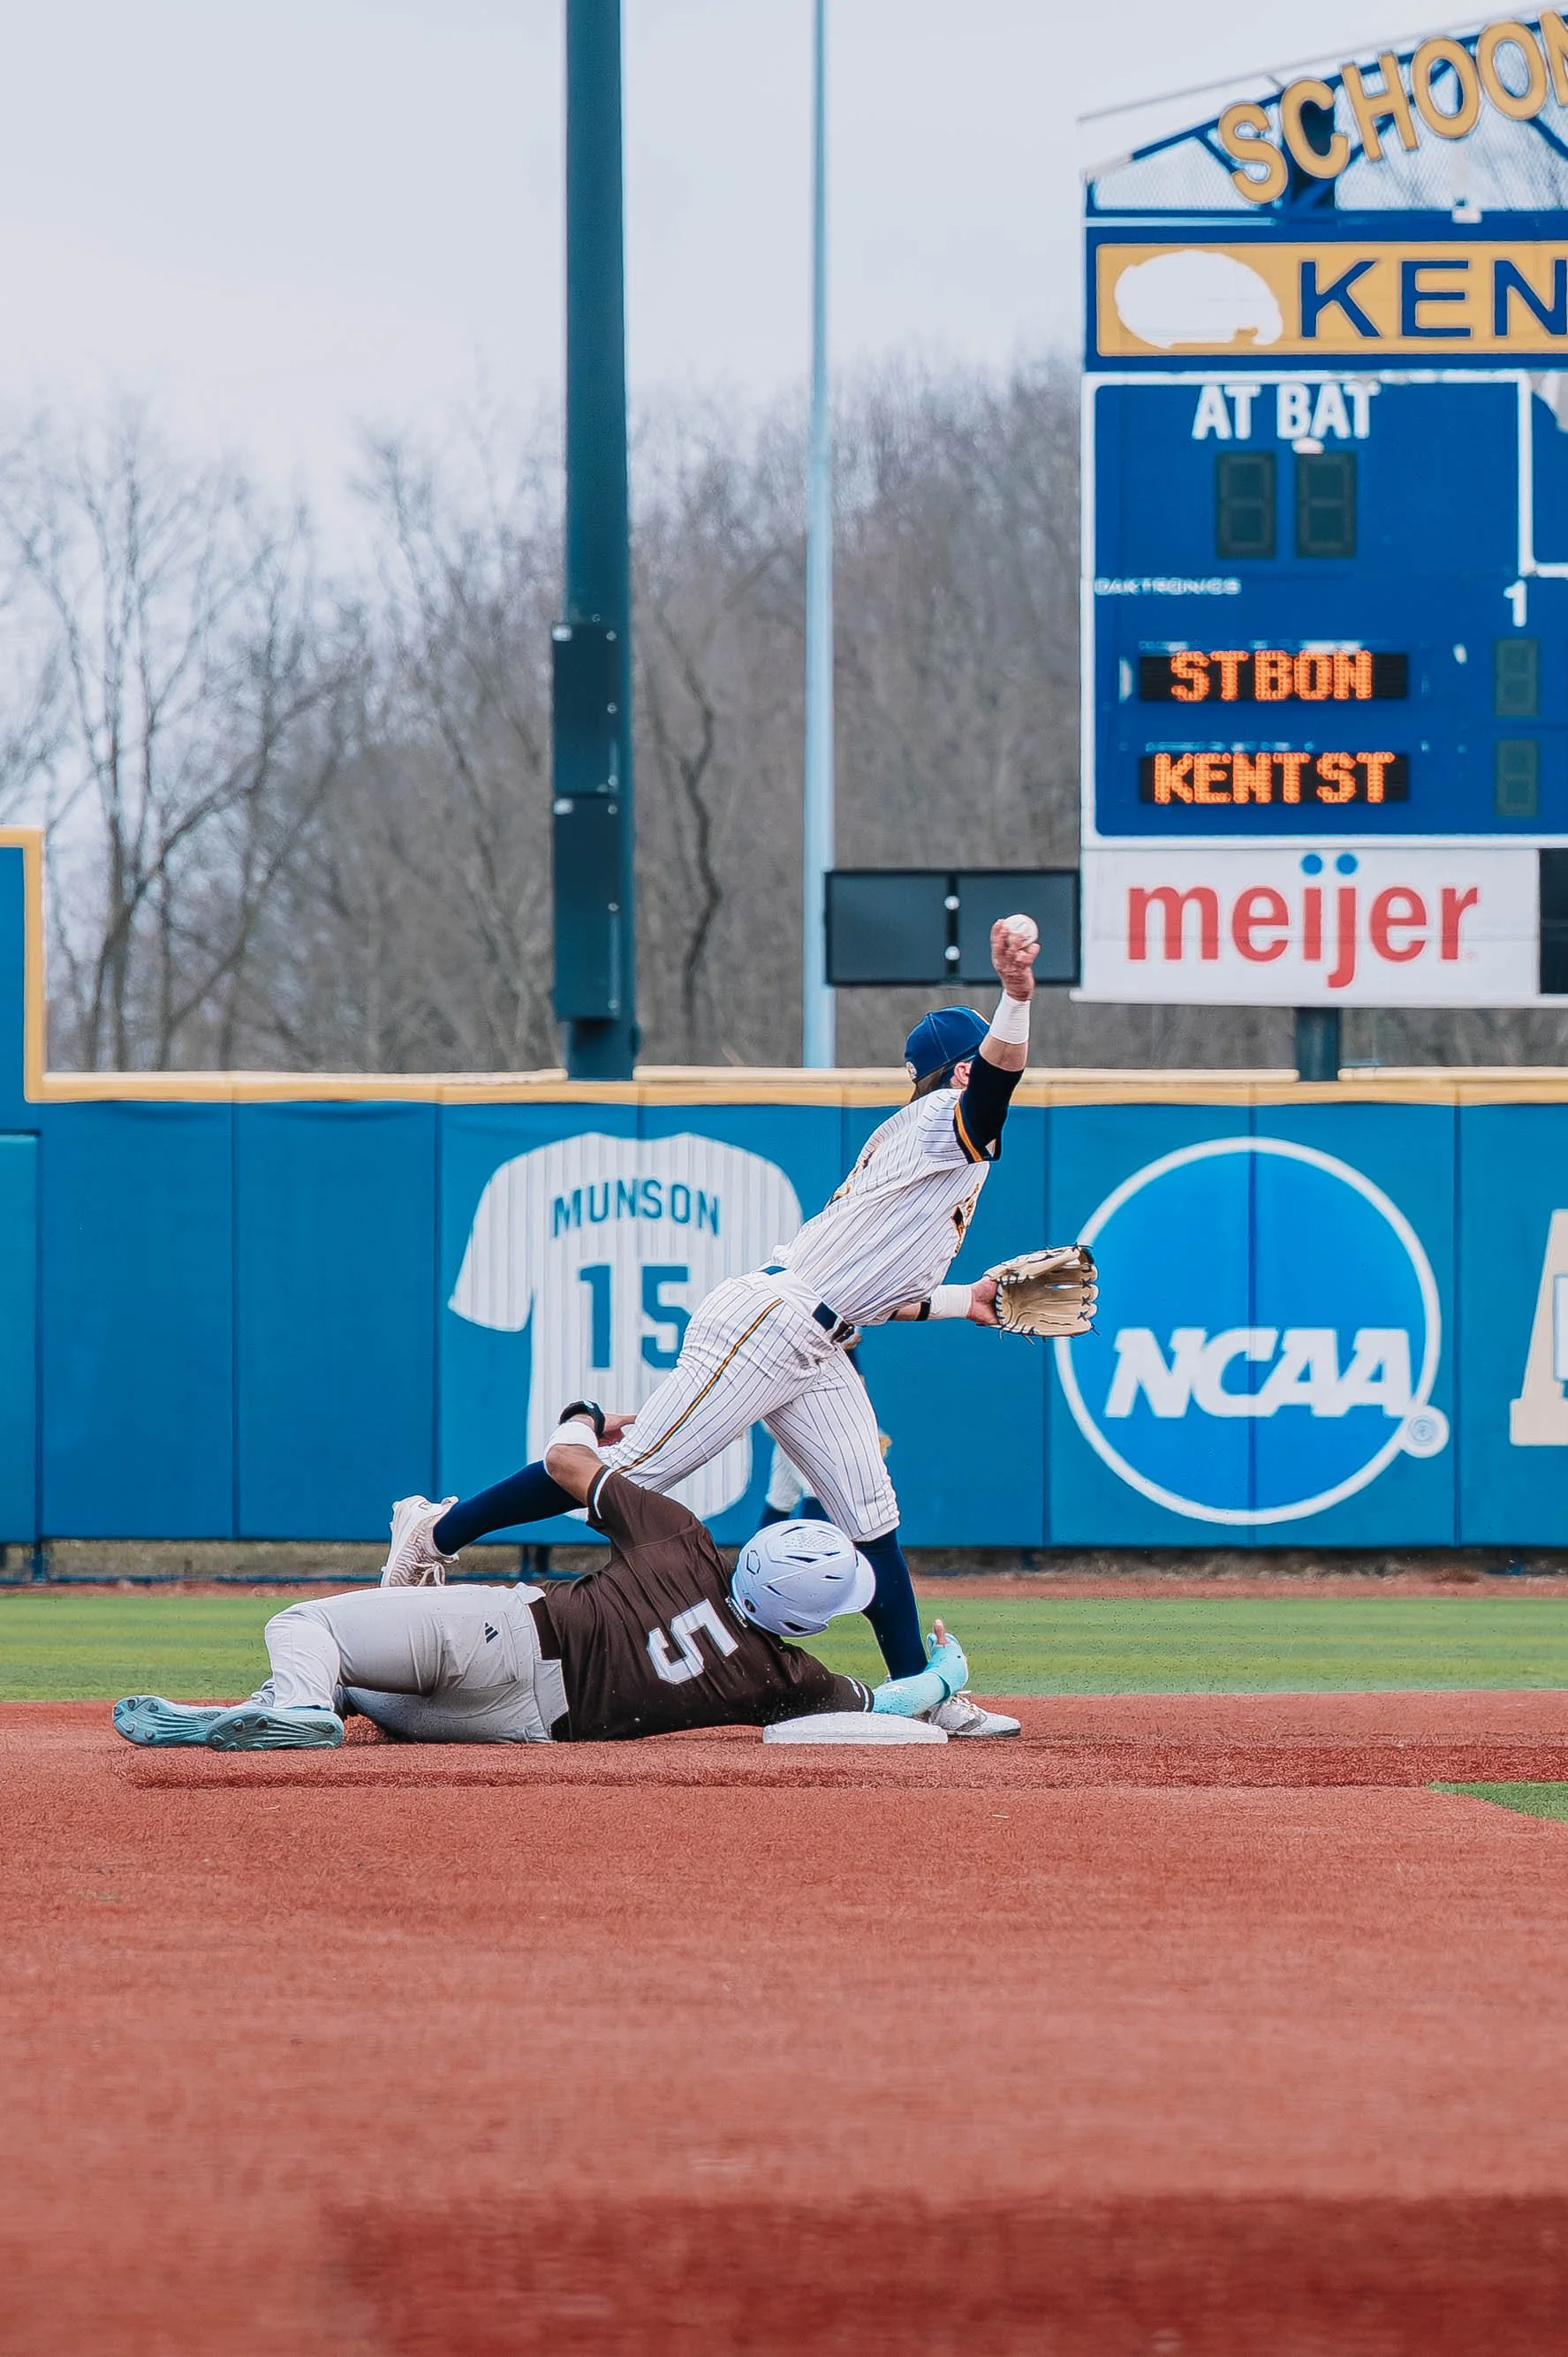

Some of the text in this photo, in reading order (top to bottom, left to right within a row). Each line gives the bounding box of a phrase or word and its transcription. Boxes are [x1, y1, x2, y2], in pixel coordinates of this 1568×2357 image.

[1191, 382, 1381, 440] AT BAT
[1503, 579, 1527, 627] 1
[1128, 853, 1479, 989] meijer
[553, 1178, 720, 1237] MUNSON
[579, 1264, 693, 1370] 15
[1103, 1328, 1415, 1418] NCAA
[646, 1598, 739, 1685] 5
